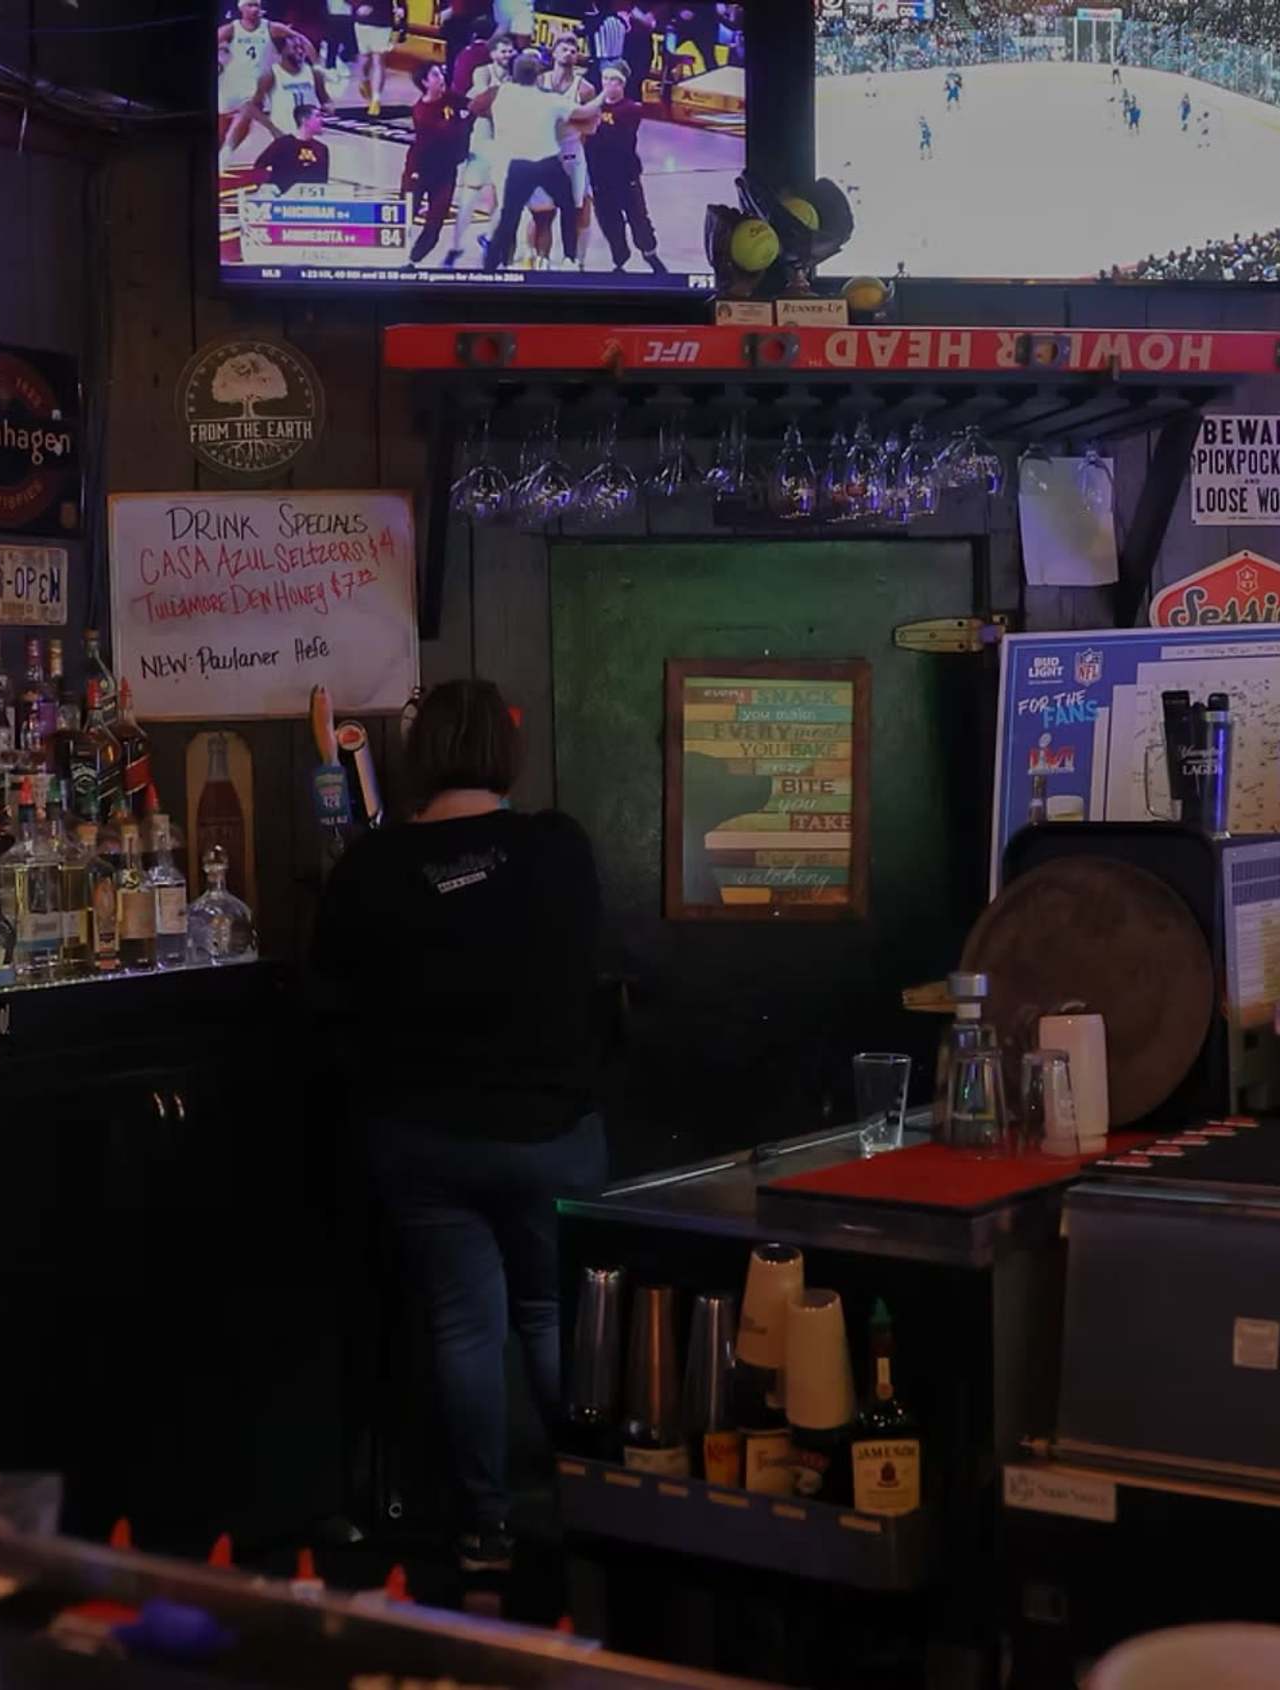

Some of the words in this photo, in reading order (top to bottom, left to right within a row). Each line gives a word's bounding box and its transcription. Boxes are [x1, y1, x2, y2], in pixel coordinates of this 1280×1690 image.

[380, 228, 401, 246] 84
[643, 341, 702, 364] UFC
[824, 330, 973, 369] HEAD
[189, 421, 230, 444] FROM
[234, 421, 261, 439] THE
[267, 420, 313, 440] EARTH
[1196, 487, 1249, 514] LOOSE
[166, 506, 260, 541] DRINK
[278, 502, 369, 540] SPECIALS
[139, 546, 210, 586] CASA
[217, 543, 272, 579] AZUL
[196, 646, 281, 675] Paulaner
[294, 636, 330, 665] Hefe
[1033, 656, 1060, 669] BUD
[1028, 666, 1065, 680] LIGHT
[1017, 695, 1050, 716] FOR
[1053, 688, 1087, 708] THE
[1042, 699, 1100, 729] FANS
[738, 743, 782, 757] YOU
[780, 778, 836, 794] BITE
[777, 799, 818, 814] you
[795, 815, 853, 830] TAKE
